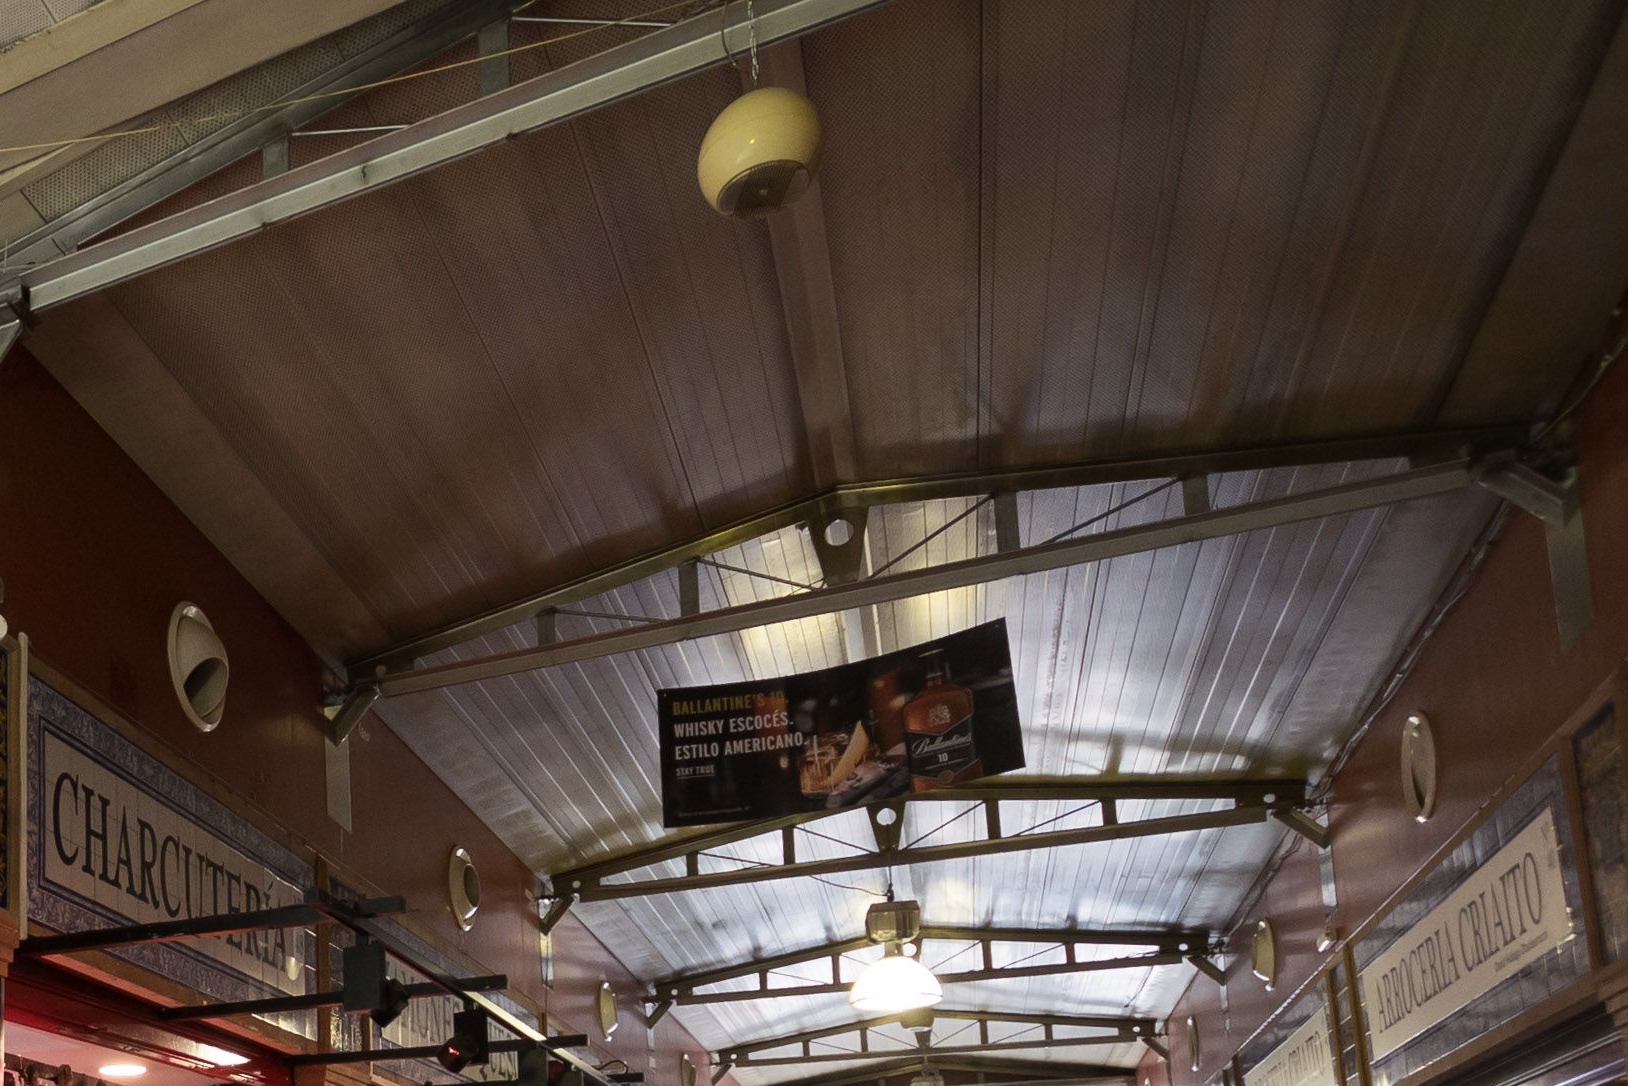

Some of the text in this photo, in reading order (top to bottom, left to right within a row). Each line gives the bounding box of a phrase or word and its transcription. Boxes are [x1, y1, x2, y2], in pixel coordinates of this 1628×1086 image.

[673, 692, 765, 716] BALLANTINE'S
[674, 709, 794, 738] WHISKY ESCOCÉS.
[675, 731, 808, 760] ESTILO AMERICANO.
[938, 752, 948, 762] 10
[676, 764, 715, 777] STAY TRUE
[1376, 920, 1461, 1034] ARROCERIA
